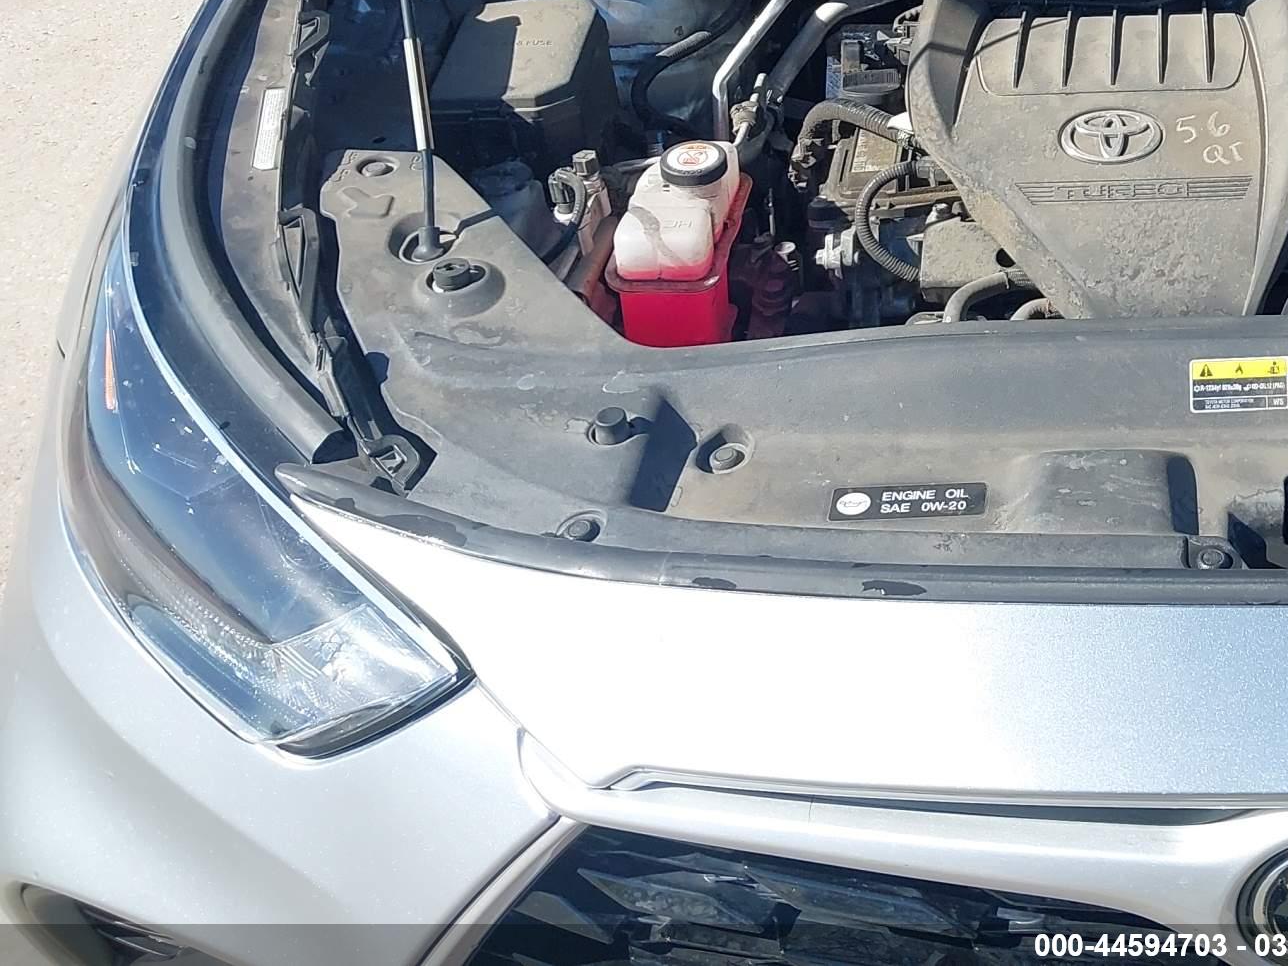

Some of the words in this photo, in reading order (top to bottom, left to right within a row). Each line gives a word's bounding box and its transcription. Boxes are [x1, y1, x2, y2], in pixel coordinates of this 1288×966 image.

[1202, 142, 1244, 165] QT
[1056, 182, 1189, 199] TURBO
[882, 489, 936, 502] ENGINE
[945, 488, 969, 499] OIL
[880, 503, 911, 513] SAE
[921, 500, 967, 512] 0W-20
